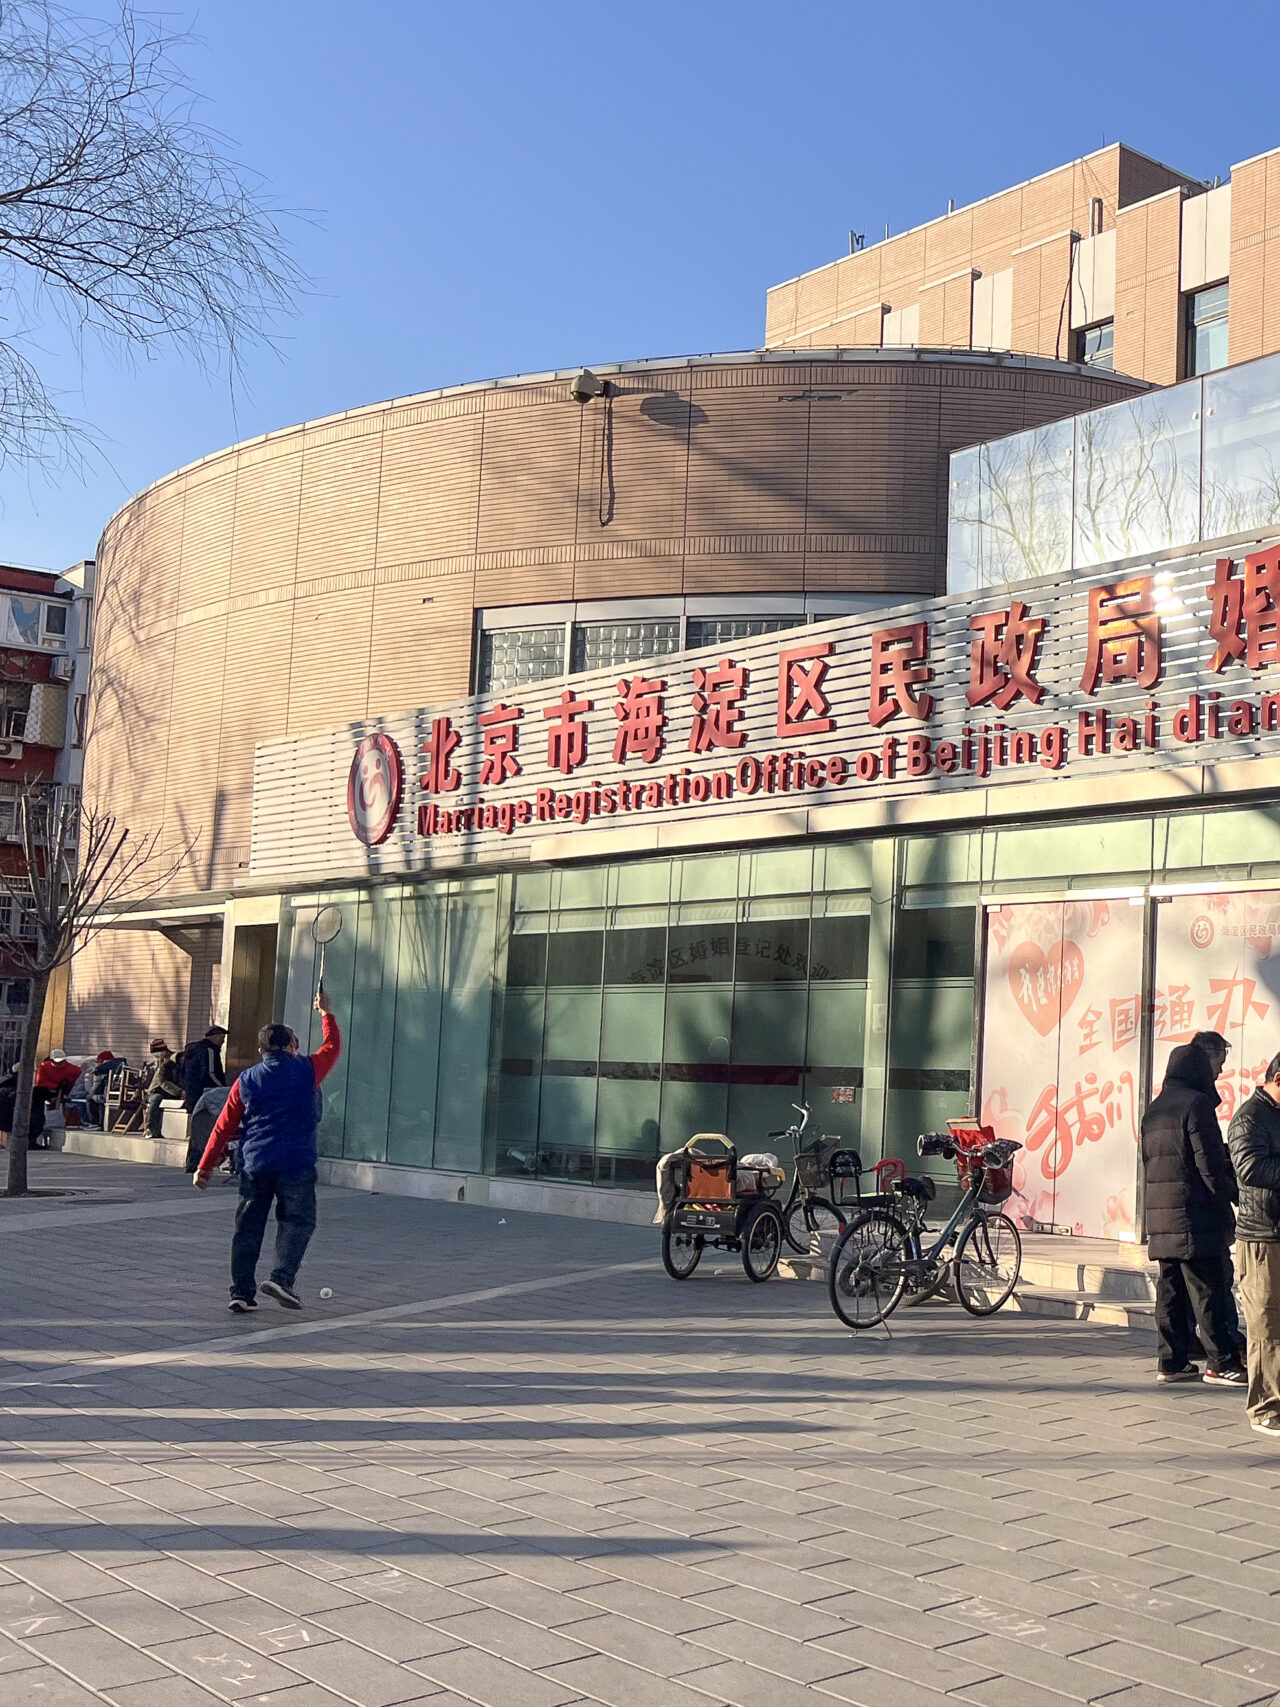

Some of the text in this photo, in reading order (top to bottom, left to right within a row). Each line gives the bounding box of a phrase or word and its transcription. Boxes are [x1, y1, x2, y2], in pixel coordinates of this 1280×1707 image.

[418, 798, 531, 835] Marriage
[536, 768, 732, 824] Registration
[736, 751, 848, 794] Office
[856, 737, 898, 781] of
[907, 723, 1065, 778] Beijing
